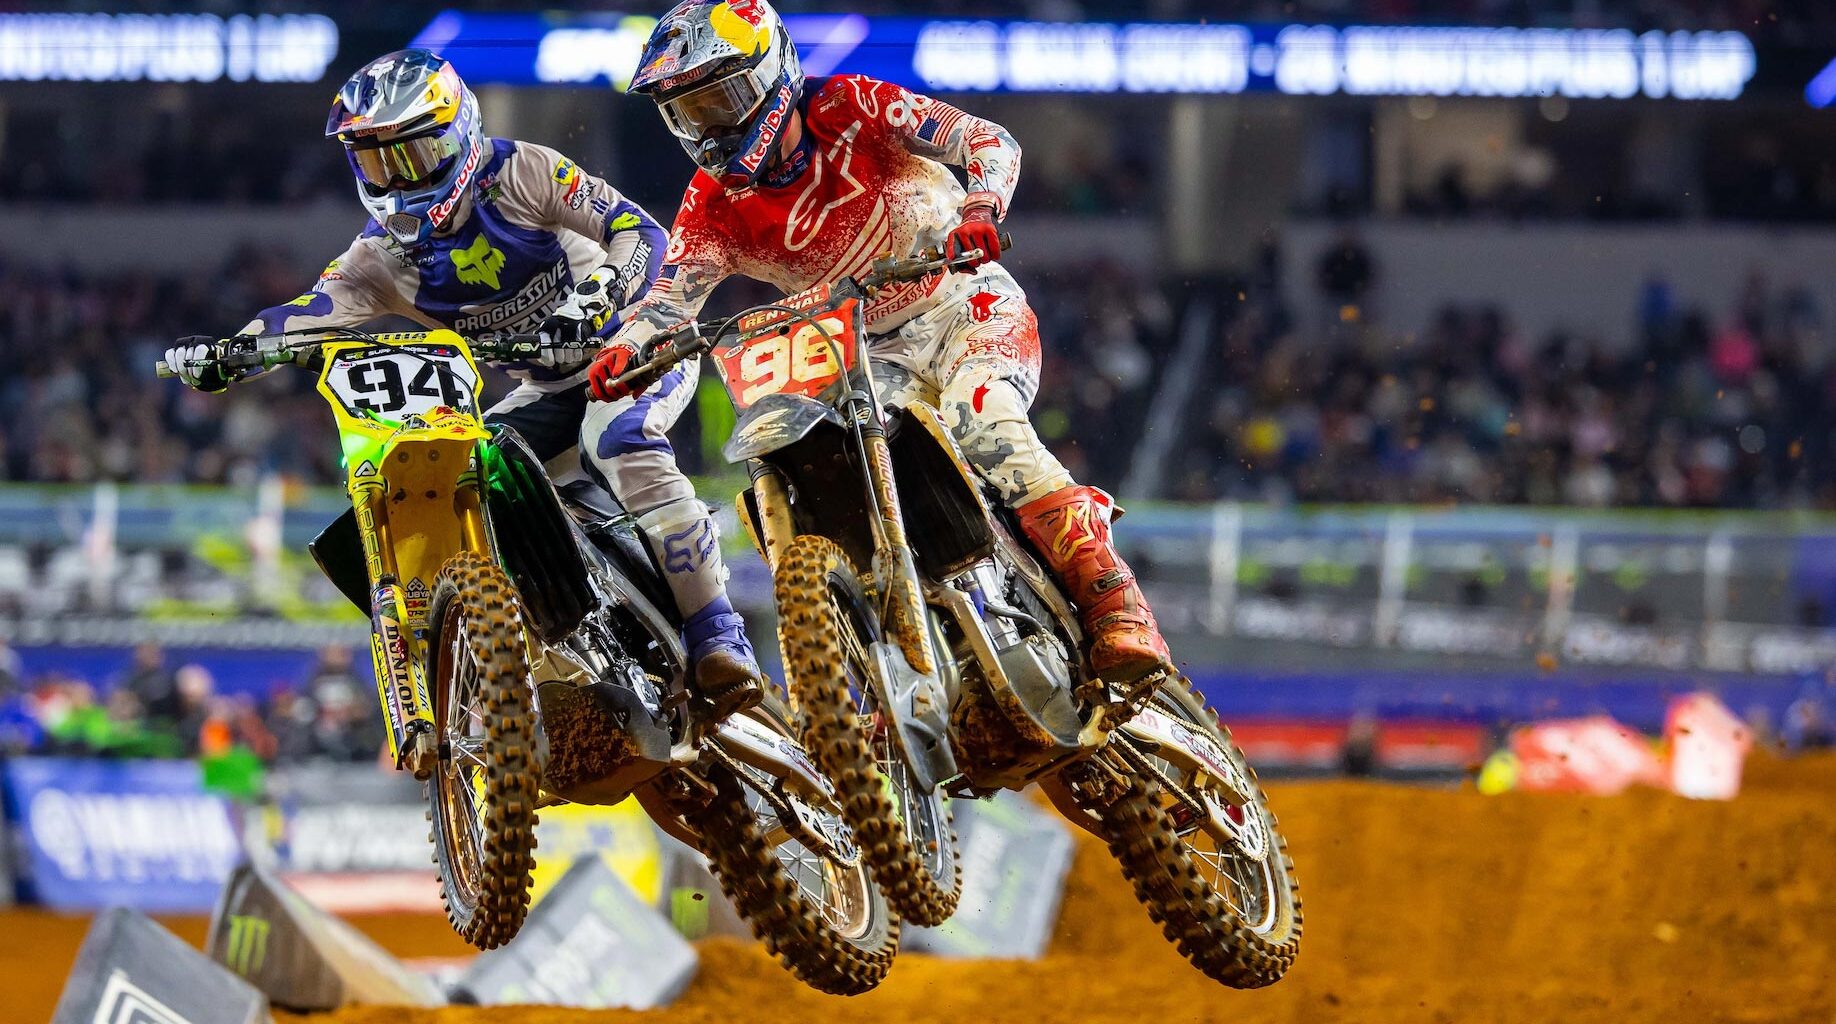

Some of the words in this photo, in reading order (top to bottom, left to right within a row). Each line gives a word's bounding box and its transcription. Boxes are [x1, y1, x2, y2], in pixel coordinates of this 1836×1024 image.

[738, 121, 774, 174] Red
[764, 85, 793, 132] Bull
[428, 178, 462, 227] Red
[456, 140, 482, 188] Bull
[454, 257, 567, 333] PROGRESSIVE
[744, 294, 825, 329] RENHAL
[368, 346, 428, 356] SUPEROSS
[511, 342, 540, 352] ASV
[561, 341, 587, 349] ASV
[740, 317, 845, 406] 96
[346, 359, 465, 413] 94
[385, 625, 416, 717] DUNLOP
